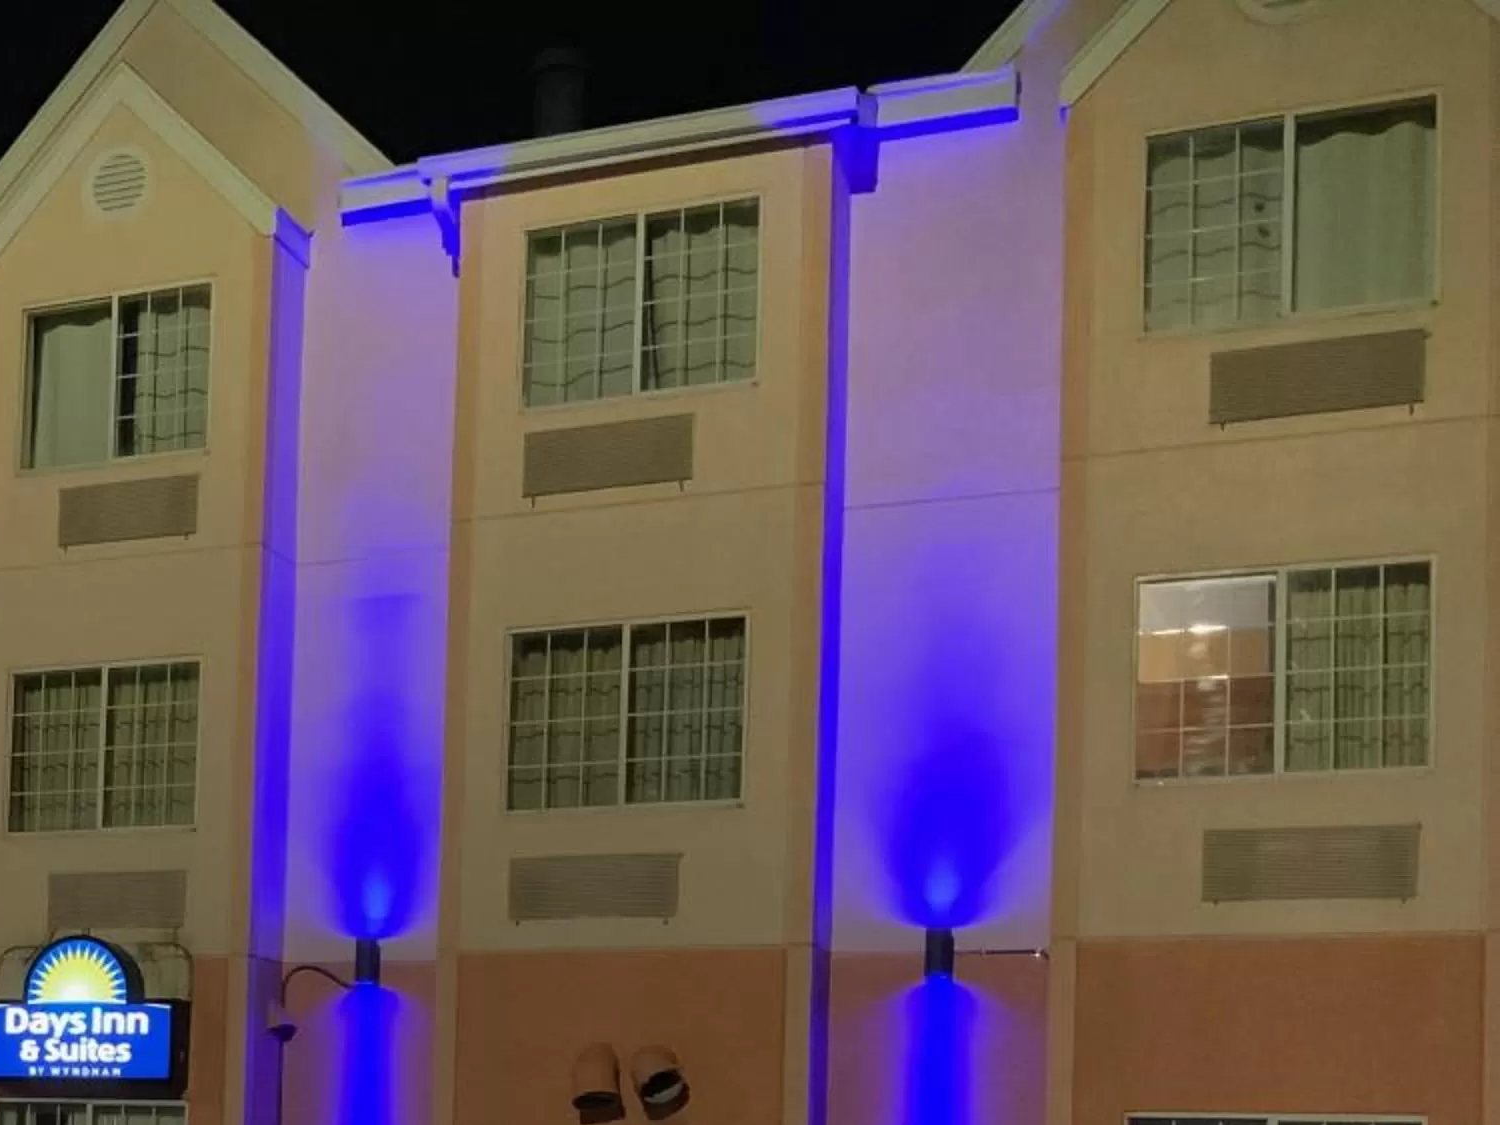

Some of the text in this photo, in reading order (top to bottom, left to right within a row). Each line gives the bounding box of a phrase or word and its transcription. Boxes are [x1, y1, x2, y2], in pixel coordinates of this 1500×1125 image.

[5, 1007, 149, 1038] Days Inn
[19, 1037, 132, 1063] & Suites
[28, 1067, 122, 1077] BY WYNDHAM
